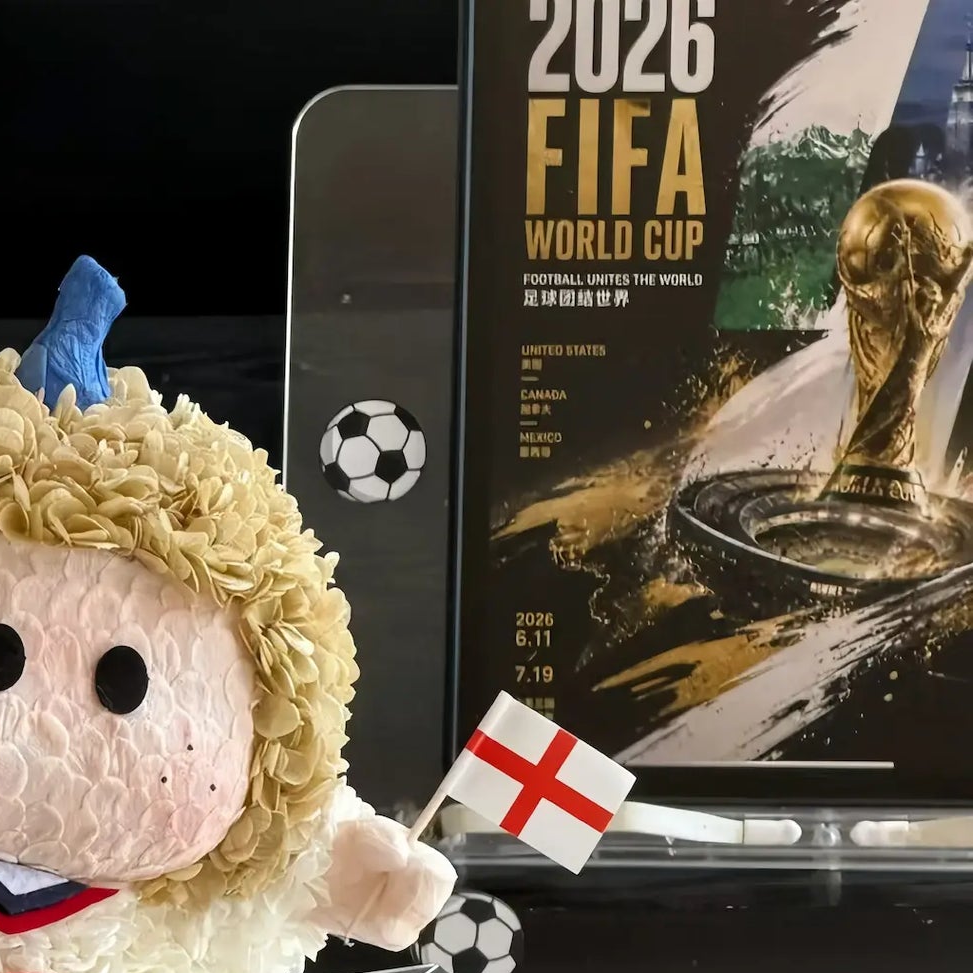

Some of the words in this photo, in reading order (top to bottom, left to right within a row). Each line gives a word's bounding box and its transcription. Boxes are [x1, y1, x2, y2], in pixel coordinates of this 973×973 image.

[528, 0, 716, 93] 2026
[526, 98, 707, 215] FIFA
[525, 219, 633, 260] WORLD
[644, 219, 704, 260] CUP
[523, 273, 584, 286] FOOTBALL
[586, 273, 630, 286] UNITES
[633, 273, 657, 286] THE
[659, 273, 703, 286] WORLD
[521, 344, 564, 357] UNITED
[566, 344, 607, 357] STATES
[520, 389, 568, 401] CANADA
[519, 431, 563, 444] MEXICO
[515, 612, 554, 628] 2026
[515, 629, 552, 648] 6.11
[515, 665, 554, 684] 7.19
